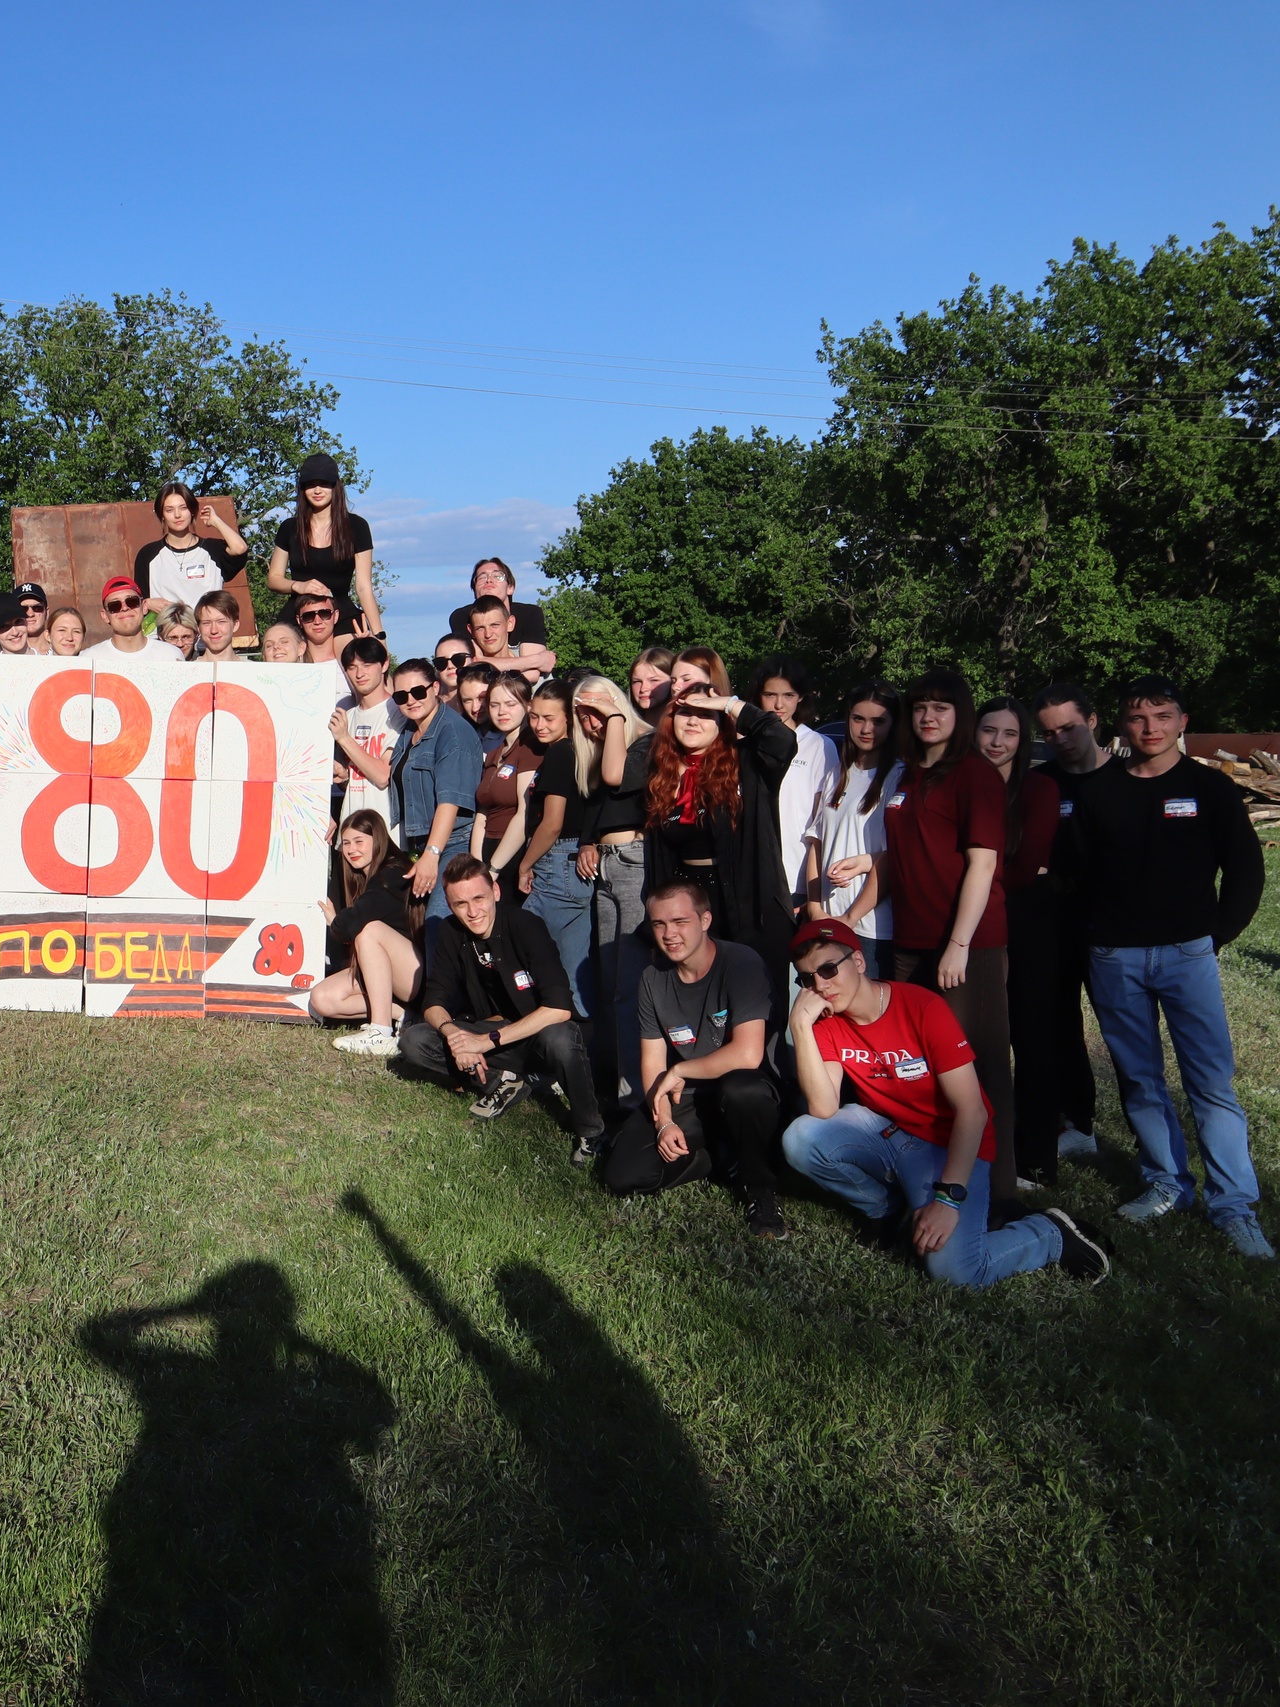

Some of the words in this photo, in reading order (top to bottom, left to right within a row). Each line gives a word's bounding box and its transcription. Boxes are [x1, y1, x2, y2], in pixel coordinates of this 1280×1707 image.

[21, 669, 277, 901] 80
[253, 922, 304, 976] 80
[841, 1048, 914, 1065] PRADA
